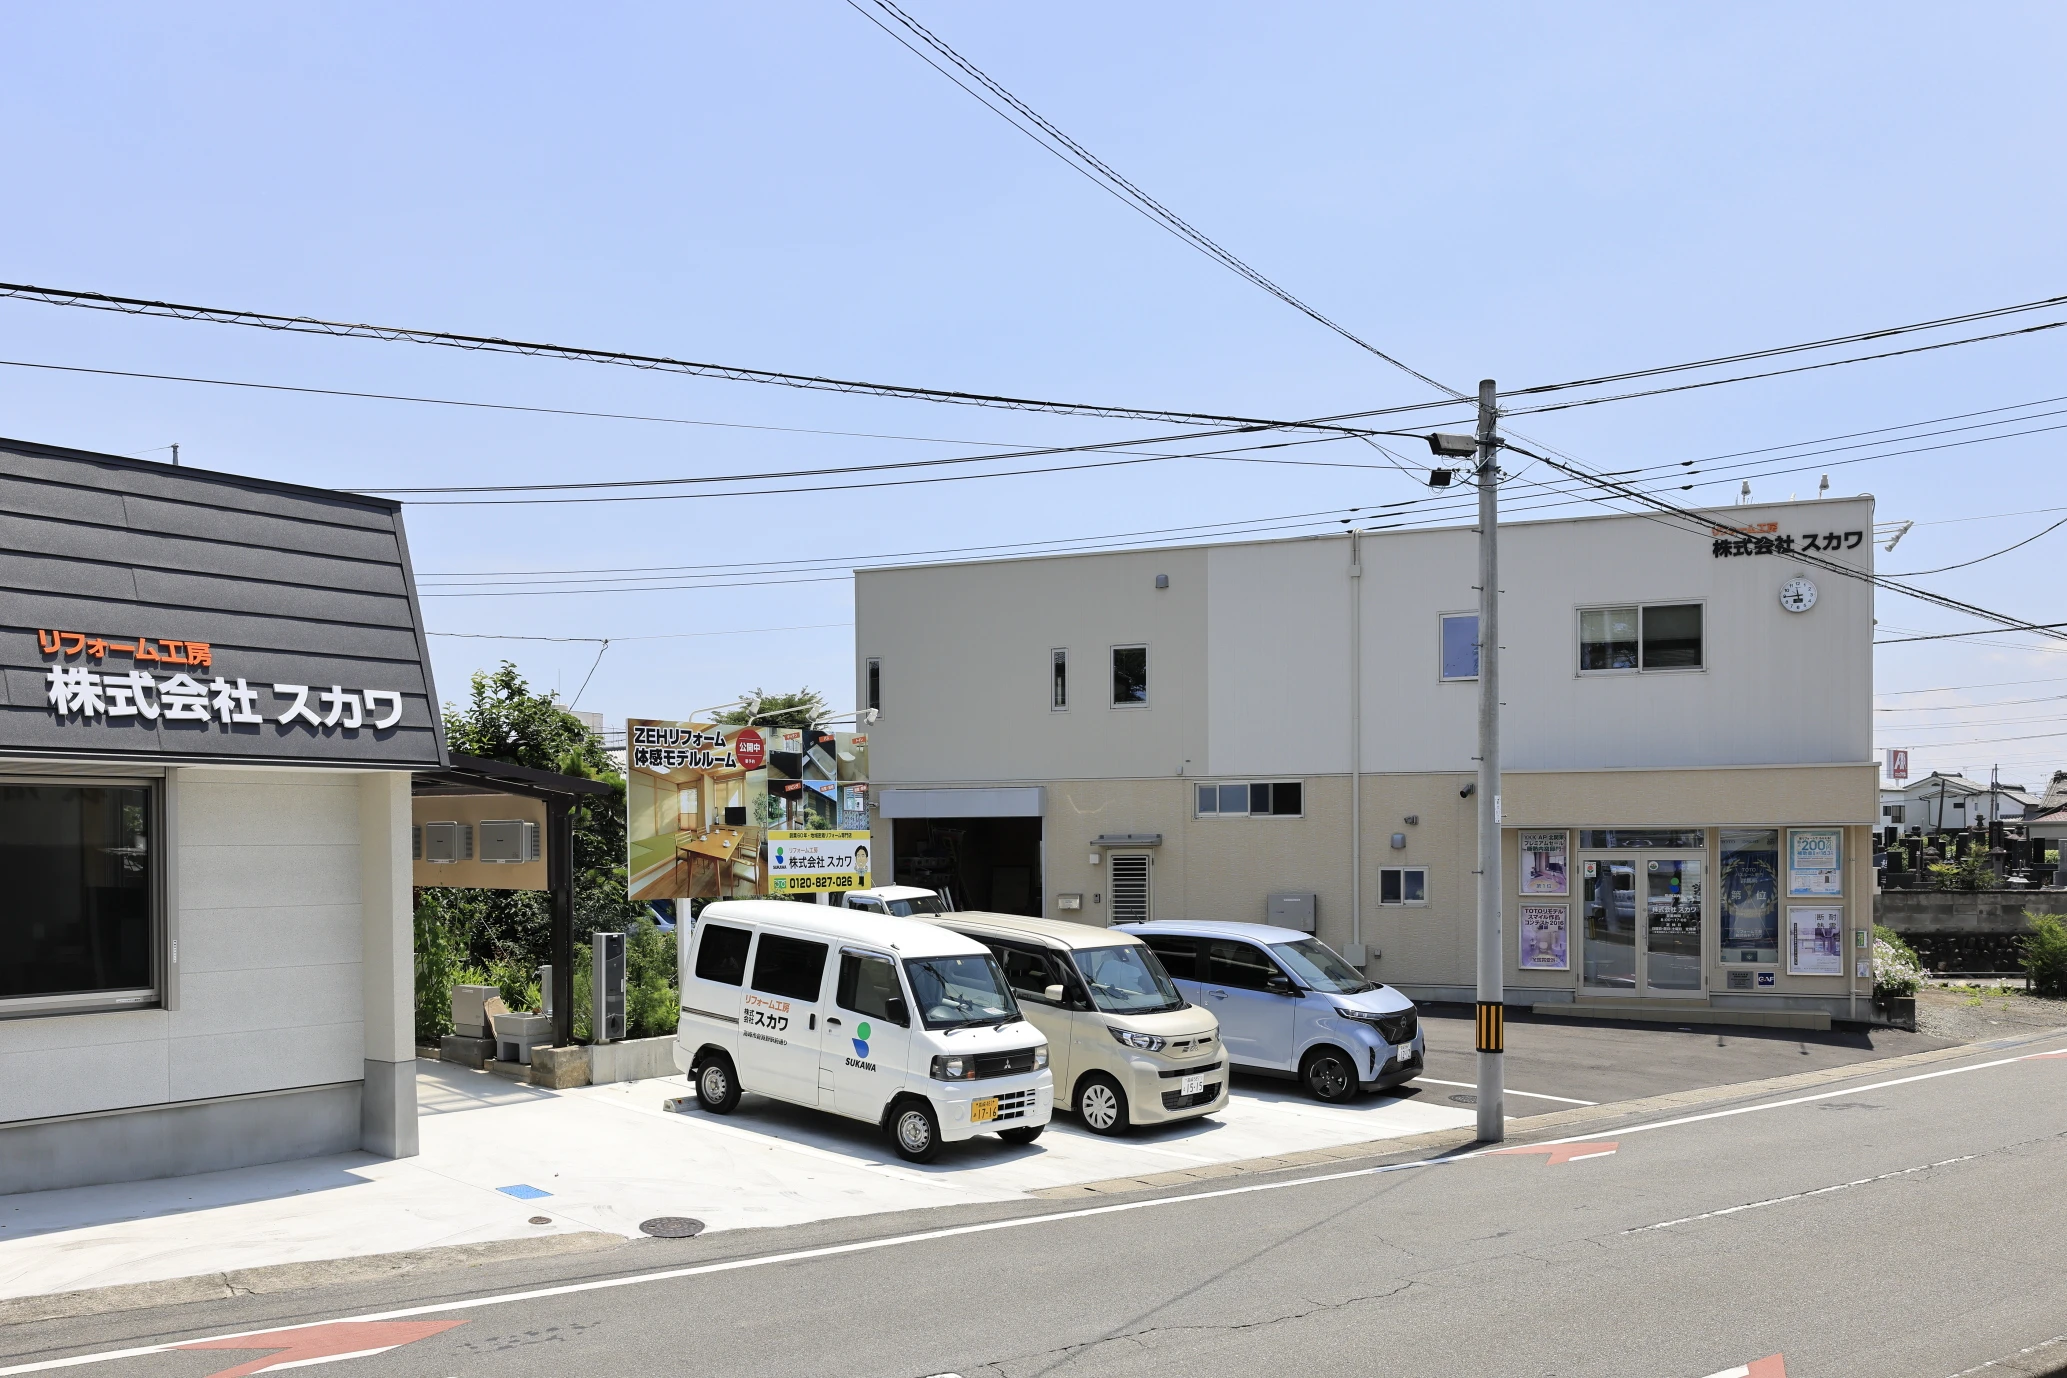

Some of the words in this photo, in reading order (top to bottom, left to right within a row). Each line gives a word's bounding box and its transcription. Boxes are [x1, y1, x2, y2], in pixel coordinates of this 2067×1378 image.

[1713, 535, 1795, 559] 株式会社
[1802, 531, 1863, 552] スカワ
[38, 629, 211, 667] リフォーム工房
[47, 665, 263, 724] 株式会社
[273, 683, 403, 729] スカワ
[634, 727, 726, 747] ZEHリフォーム
[739, 743, 761, 753] 公開中
[634, 748, 737, 769] 体感モデルルーム
[1802, 840, 1825, 850] 200
[789, 856, 825, 869] 株式会社
[827, 855, 852, 868] スカワ
[745, 994, 791, 1013] リフォーム工房
[743, 1015, 754, 1025] 会社
[744, 1008, 754, 1018] 株式
[755, 1011, 789, 1031] スカワ
[845, 1057, 876, 1072] SUKAWA
[1187, 1081, 1203, 1093] 15-15
[978, 1106, 997, 1119] 17-16
